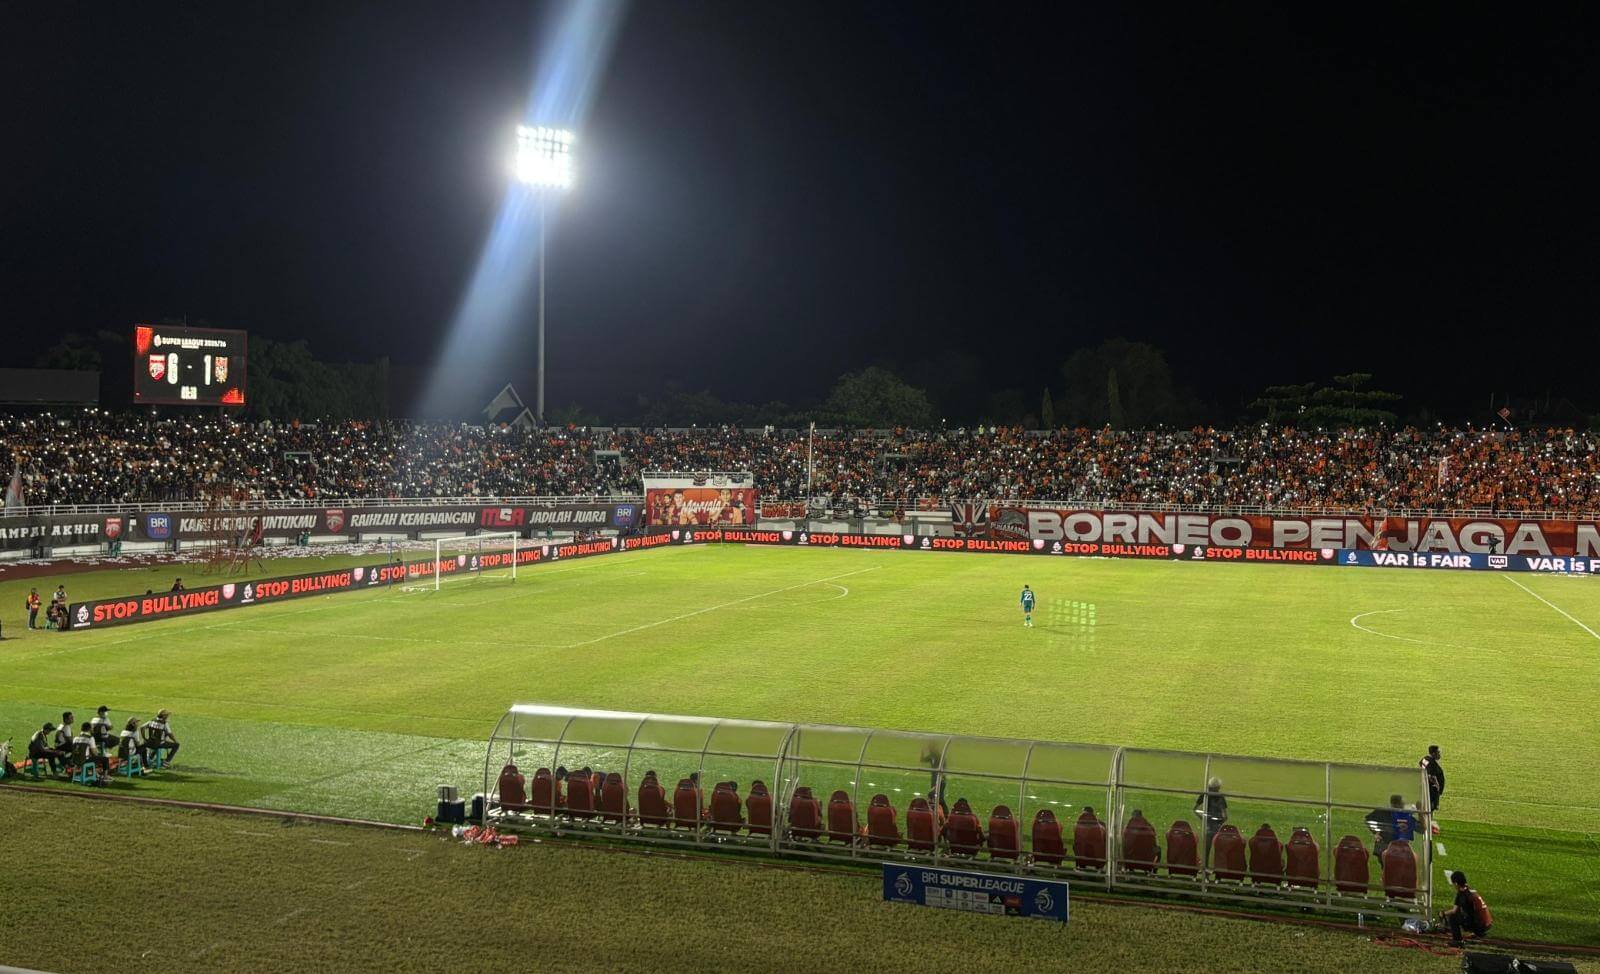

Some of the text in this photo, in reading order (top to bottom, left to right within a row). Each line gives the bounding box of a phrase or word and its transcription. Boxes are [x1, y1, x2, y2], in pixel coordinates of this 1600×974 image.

[204, 355, 211, 385] 1
[530, 511, 607, 524] JADILAH JUARA
[617, 508, 631, 517] BRI
[151, 517, 168, 528] BRI
[262, 515, 317, 530] UNTUKMU
[350, 512, 476, 527] RAIHLAH KEMENANGAN
[51, 524, 99, 536] AKHIR
[694, 531, 779, 542] STOP BULLYING!
[1028, 511, 1252, 547] BORNEO
[1273, 519, 1549, 555] PENJAGA
[626, 534, 671, 548] STOP BULLYING!
[810, 535, 900, 546] STOP BULLYING!
[933, 539, 1029, 551] STOP BULLYING!
[560, 542, 610, 557] STOP BULLYING!
[1065, 543, 1168, 556] STOP BULLYING!
[1207, 548, 1317, 560] STOP BULLYING!
[480, 555, 501, 566] STOP
[1373, 552, 1471, 568] VAR is FAIR
[1527, 557, 1565, 571] VAR
[1570, 557, 1585, 571] is
[380, 566, 406, 581] STOP
[257, 573, 350, 598] STOP BULLYING!
[94, 591, 219, 621] STOP BULLYING!
[921, 872, 938, 884] BRI
